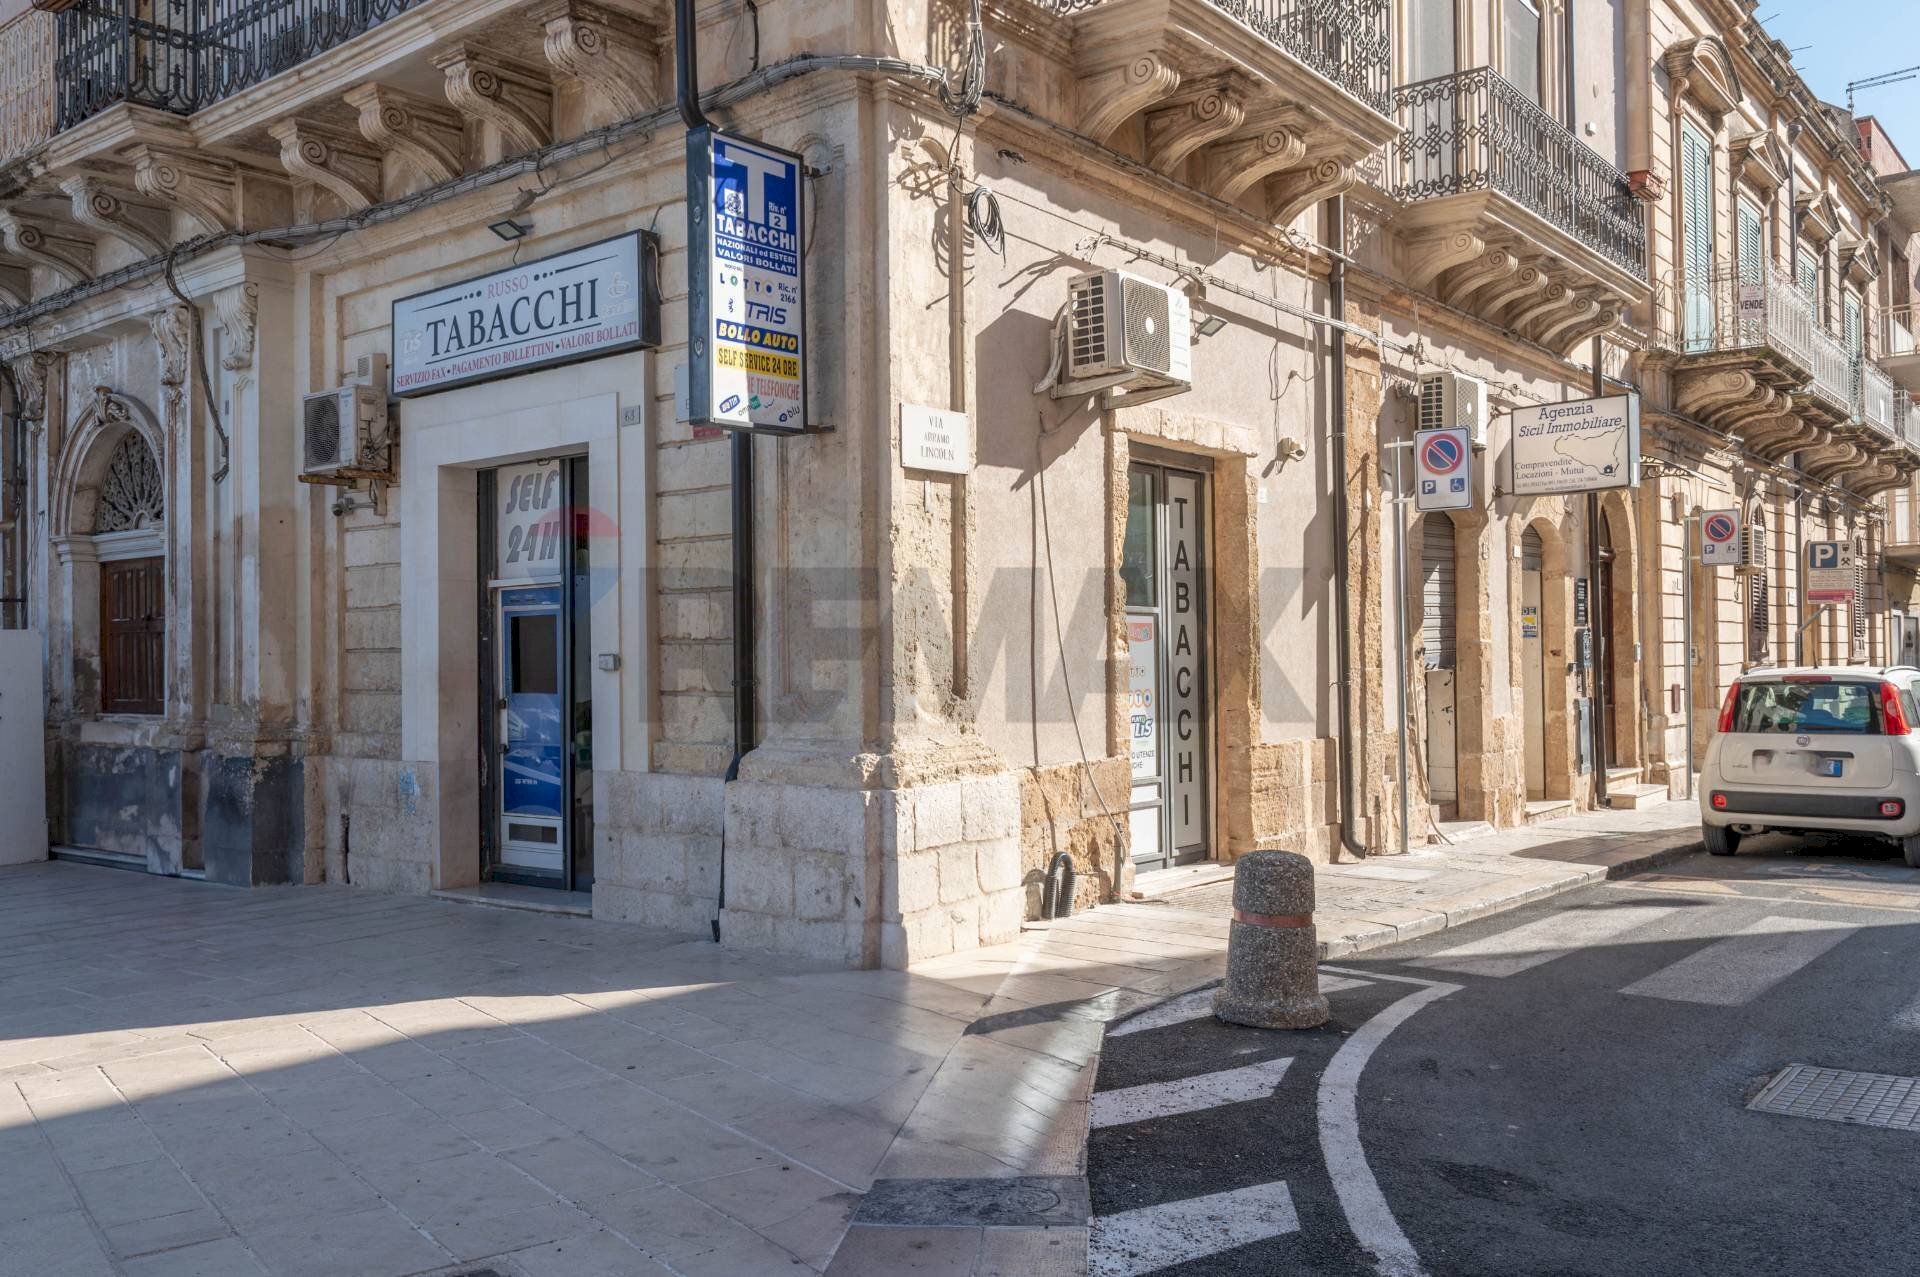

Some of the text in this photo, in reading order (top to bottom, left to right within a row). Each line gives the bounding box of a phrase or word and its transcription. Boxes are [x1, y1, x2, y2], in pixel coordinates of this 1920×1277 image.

[724, 144, 786, 224] T
[716, 213, 796, 251] TABACCHI
[774, 215, 782, 227] 2
[717, 237, 796, 264] NAZIONALI ed ESTERI
[717, 247, 753, 264] VALORI
[756, 257, 796, 275] BOLLATI
[487, 274, 529, 299] RUSSO
[426, 277, 599, 357] TABACCHI
[746, 300, 787, 325] TRIS
[1740, 299, 1764, 310] VENDE
[719, 322, 797, 351] BOLLO AUTO
[395, 321, 638, 388] SERVIZIO FAX PAGAMENTO BOLLETTINI VALORI BOLLATI
[718, 347, 797, 377] SELF SERVICE 24 ORE
[757, 377, 800, 401] TELEFONICHE
[928, 415, 944, 429] VIA
[1538, 402, 1594, 422] Agenzia
[924, 431, 950, 444] ABRAMO
[1518, 415, 1622, 438] Sicil Immobiliare
[920, 444, 954, 461] LINCOLN
[1514, 458, 1573, 472] Compravendite
[1516, 468, 1553, 480] Locazioni
[1560, 466, 1585, 477] Mutui
[505, 469, 560, 514] SELF
[1815, 544, 1834, 568] P
[1174, 497, 1193, 826] TABACCHI
